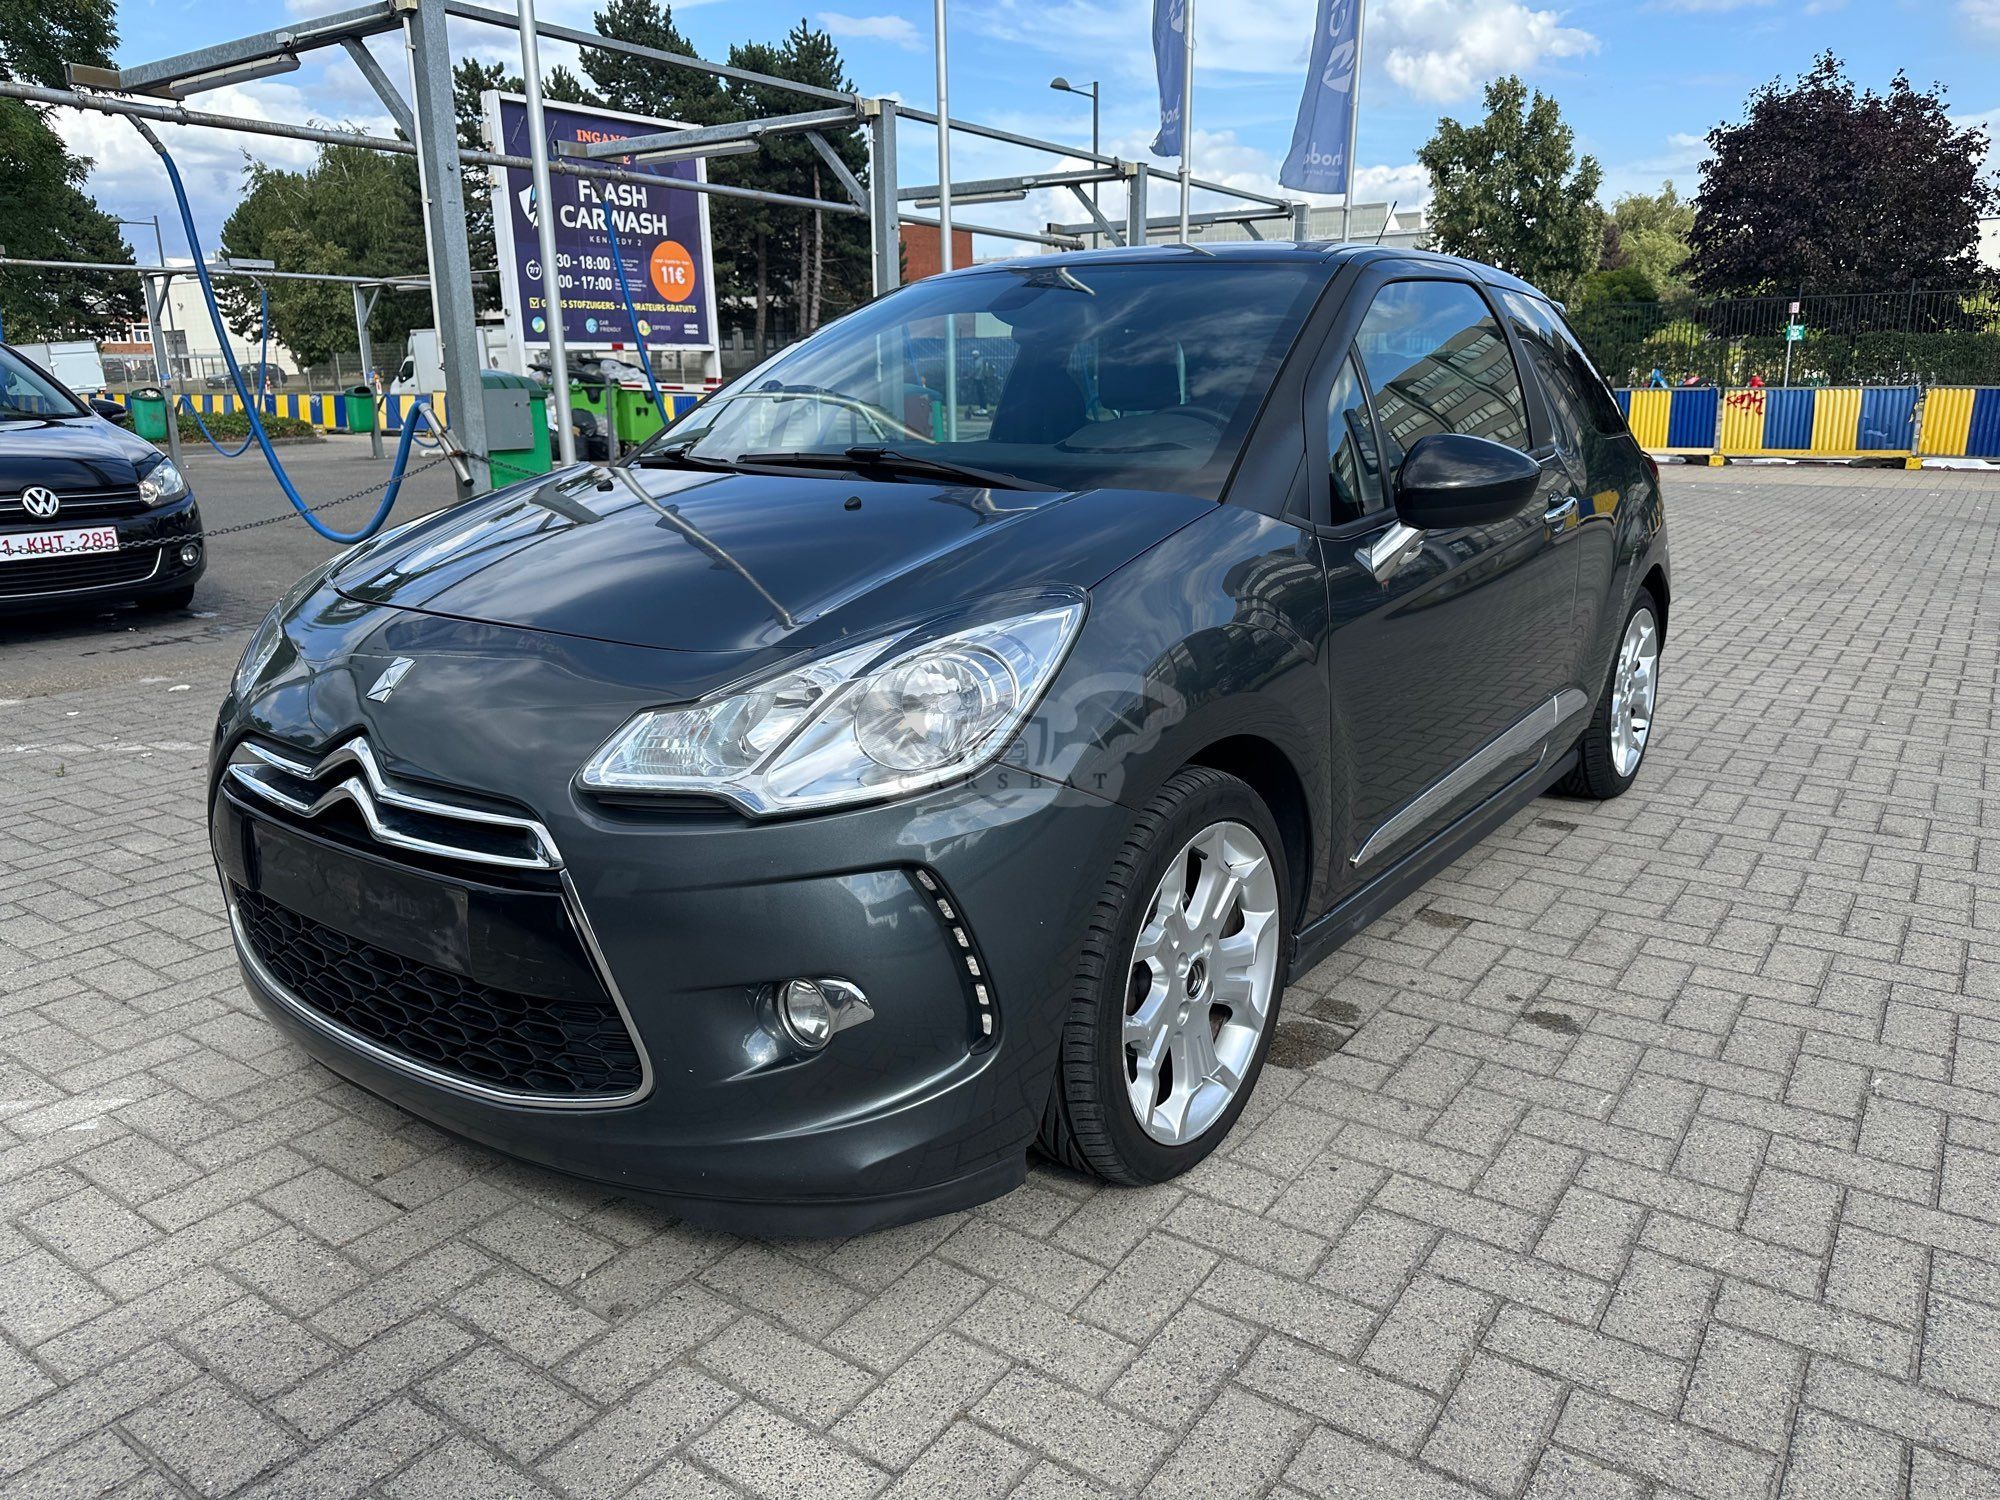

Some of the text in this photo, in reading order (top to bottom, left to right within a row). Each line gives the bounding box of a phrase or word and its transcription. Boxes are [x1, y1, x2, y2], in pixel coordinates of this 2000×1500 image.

[589, 235, 642, 247] KENEDY 2
[661, 265, 686, 285] 11€
[568, 299, 616, 310] STOFZUIGERS
[666, 303, 697, 314] GRATUITS
